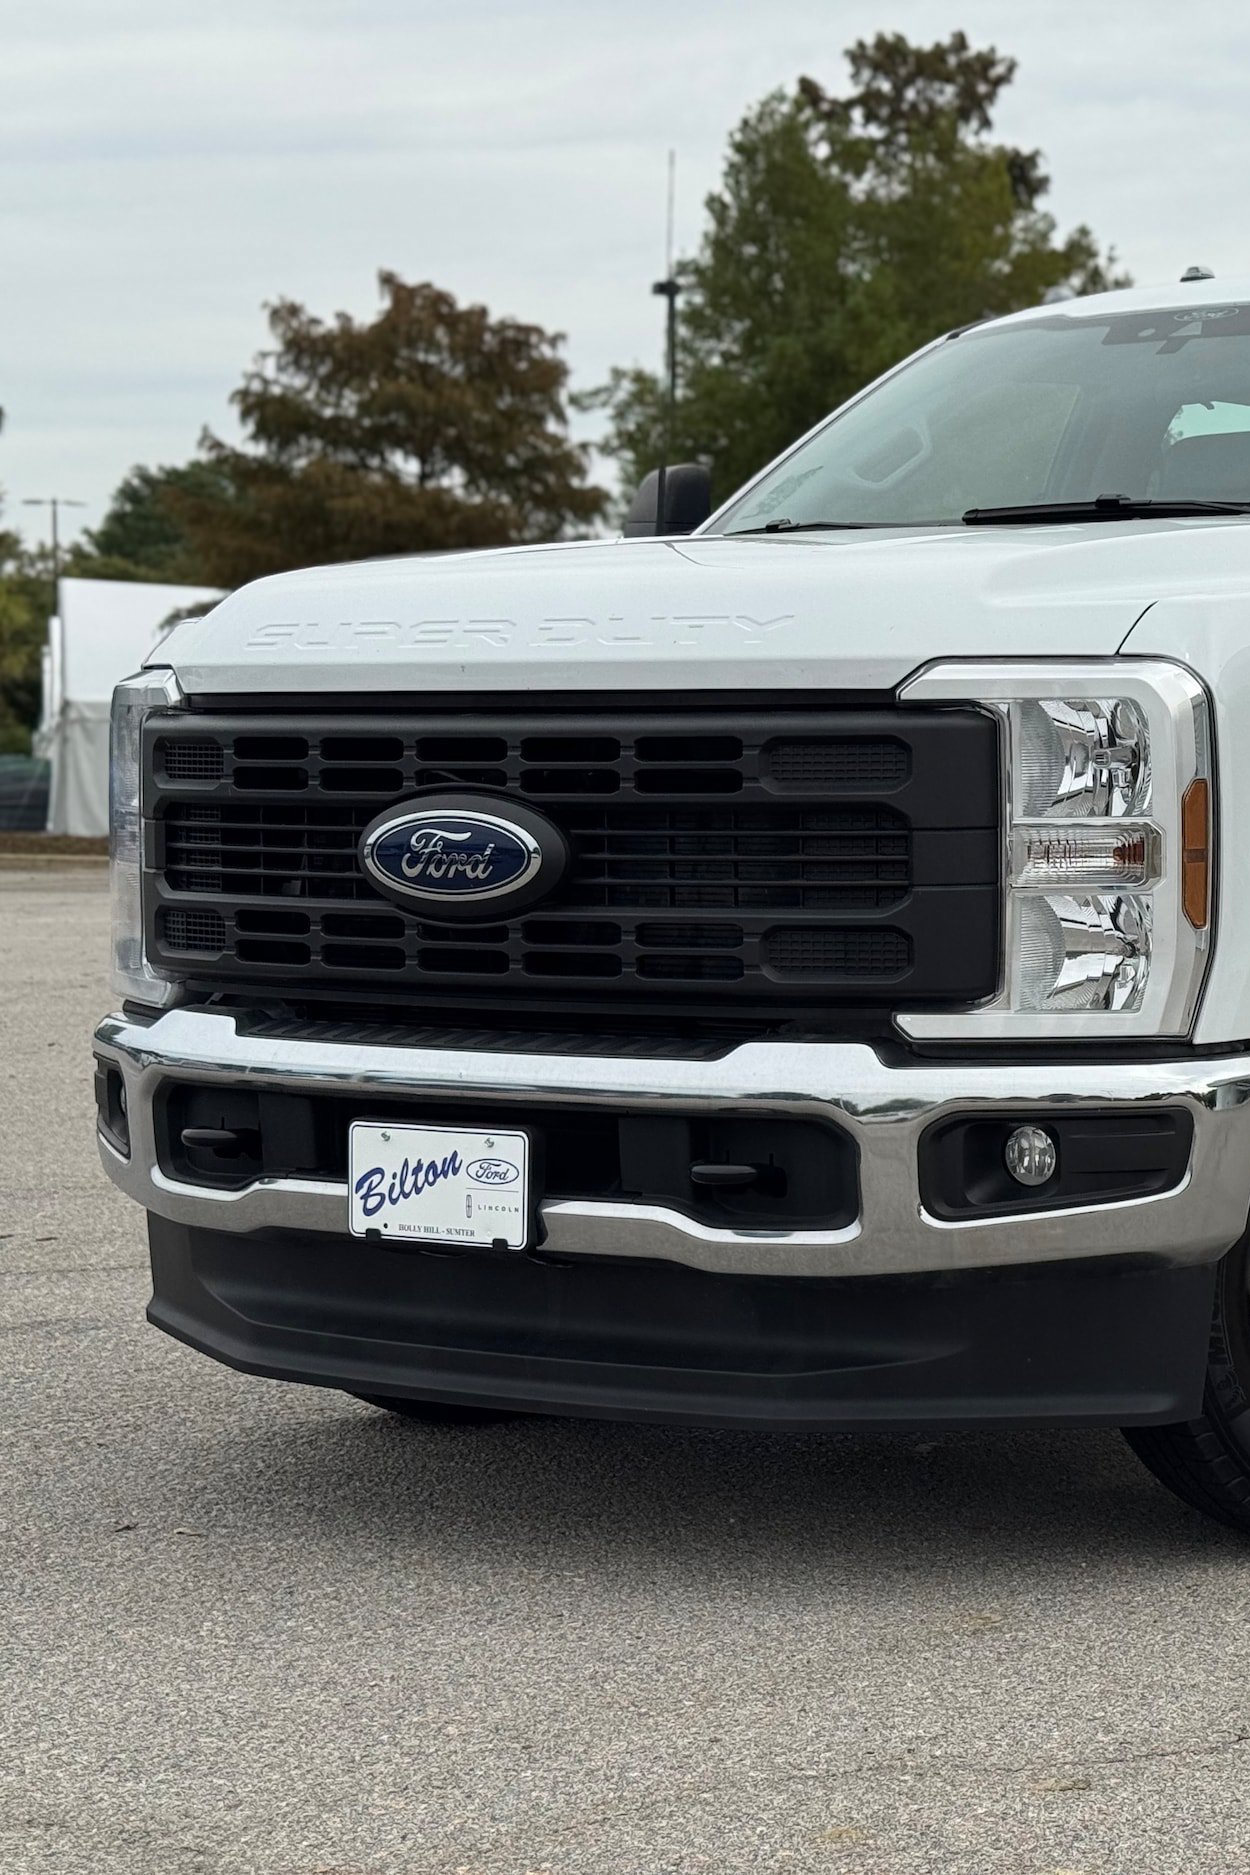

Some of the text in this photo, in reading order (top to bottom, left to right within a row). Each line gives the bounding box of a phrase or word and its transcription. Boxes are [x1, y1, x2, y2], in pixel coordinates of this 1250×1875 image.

[244, 613, 796, 650] SUPER DUTY
[401, 828, 496, 880] Ford
[355, 1149, 463, 1217] Bilton
[475, 1161, 510, 1181] Ford
[477, 1204, 520, 1213] LINCOLN
[398, 1223, 422, 1233] HOLLY
[423, 1225, 441, 1235] HILL
[446, 1227, 475, 1238] SUMTER
